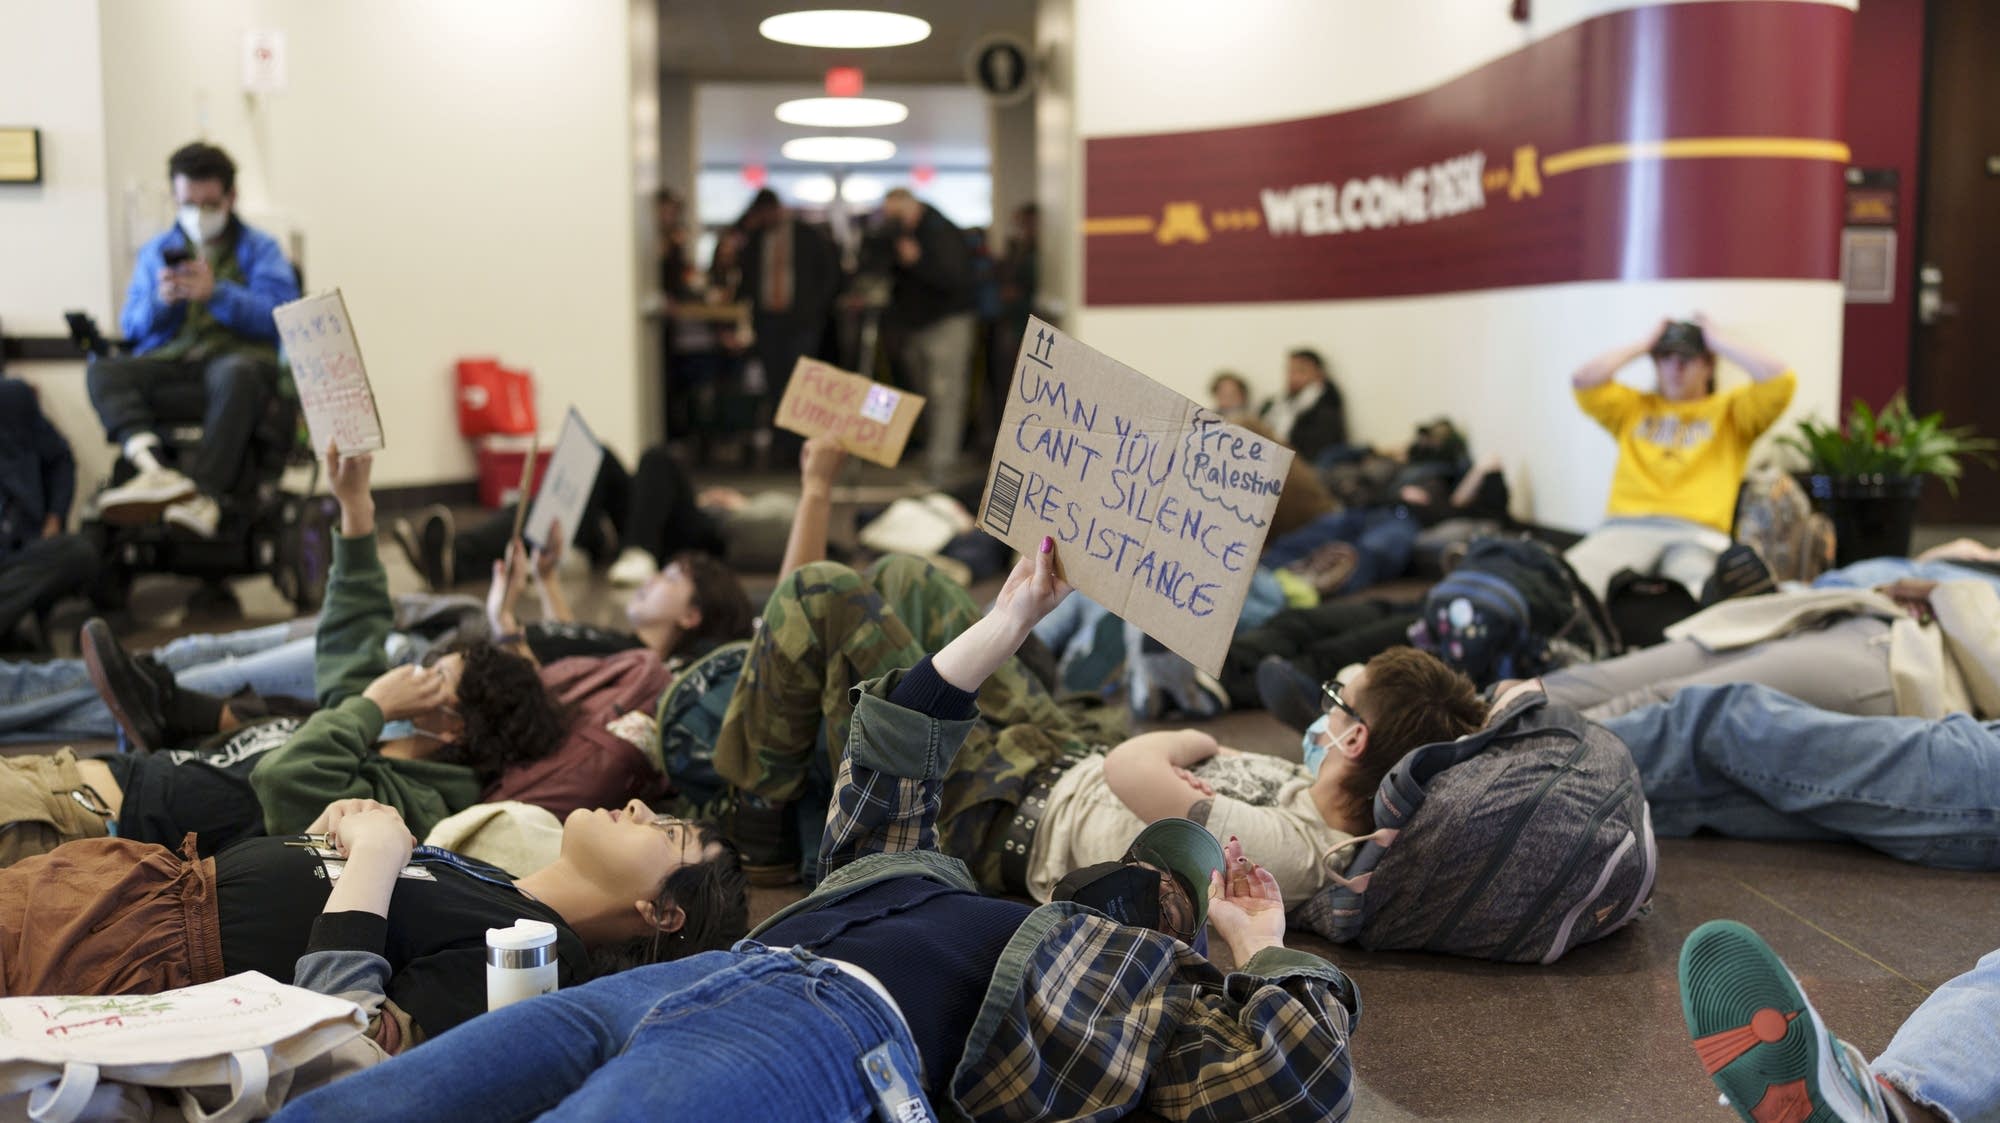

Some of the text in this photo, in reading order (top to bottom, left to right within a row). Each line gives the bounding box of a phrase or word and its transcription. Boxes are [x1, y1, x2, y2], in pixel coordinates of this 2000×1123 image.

[1260, 167, 1427, 237] WELCOME
[1019, 365, 1176, 486] UMN YOU
[1200, 419, 1266, 462] Free
[1016, 413, 1248, 572] CAN'T SILENCE
[1192, 452, 1282, 497] Palestine
[1023, 471, 1222, 617] RESISTANCE
[426, 846, 441, 857] THE
